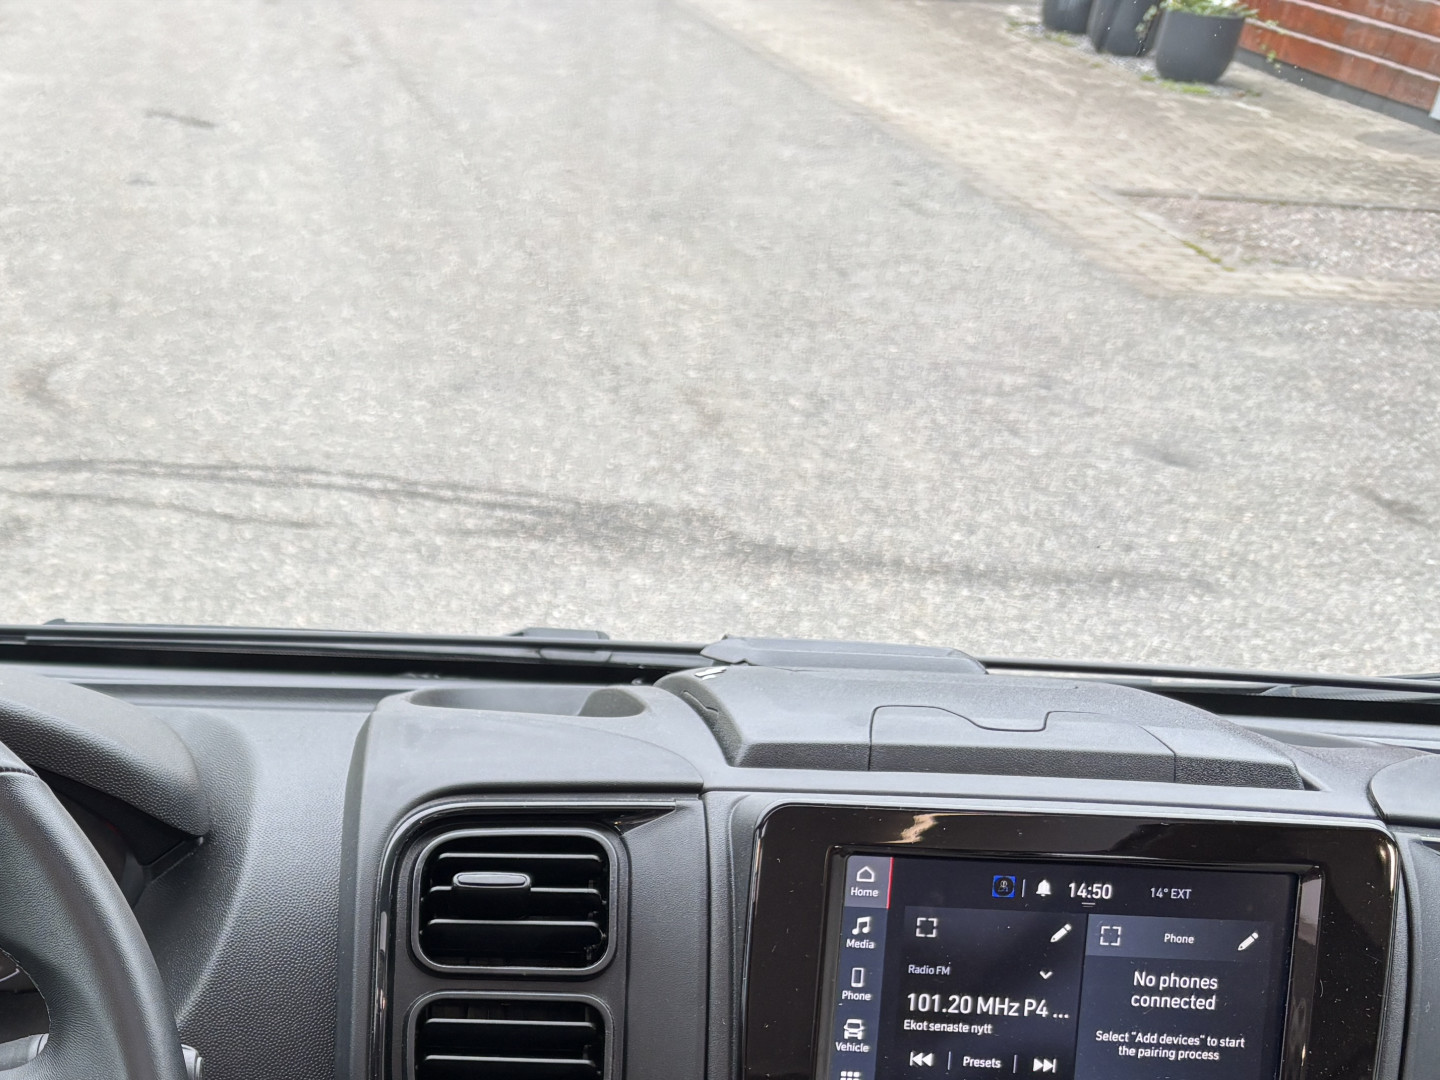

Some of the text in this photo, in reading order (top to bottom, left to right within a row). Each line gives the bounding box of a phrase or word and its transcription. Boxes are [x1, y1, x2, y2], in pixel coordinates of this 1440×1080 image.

[850, 887, 879, 897] Home
[1068, 882, 1112, 900] 14:50
[1170, 889, 1192, 900] EXT
[846, 939, 875, 950] Media
[1164, 933, 1195, 944] Phone
[908, 964, 951, 976] Radio FM
[1133, 971, 1218, 991] No phones
[841, 990, 872, 1001] Phone
[1131, 994, 1216, 1010] connected
[907, 993, 972, 1014] 101.20
[977, 997, 1019, 1017] MHz
[903, 1019, 993, 1036] Ekot senaste nytt
[1095, 1030, 1130, 1043] Select
[1206, 1035, 1218, 1047] to
[1219, 1036, 1245, 1048] start
[835, 1042, 870, 1053] Vehicle
[1118, 1045, 1220, 1061] the pairing process
[963, 1056, 1002, 1069] Presets
